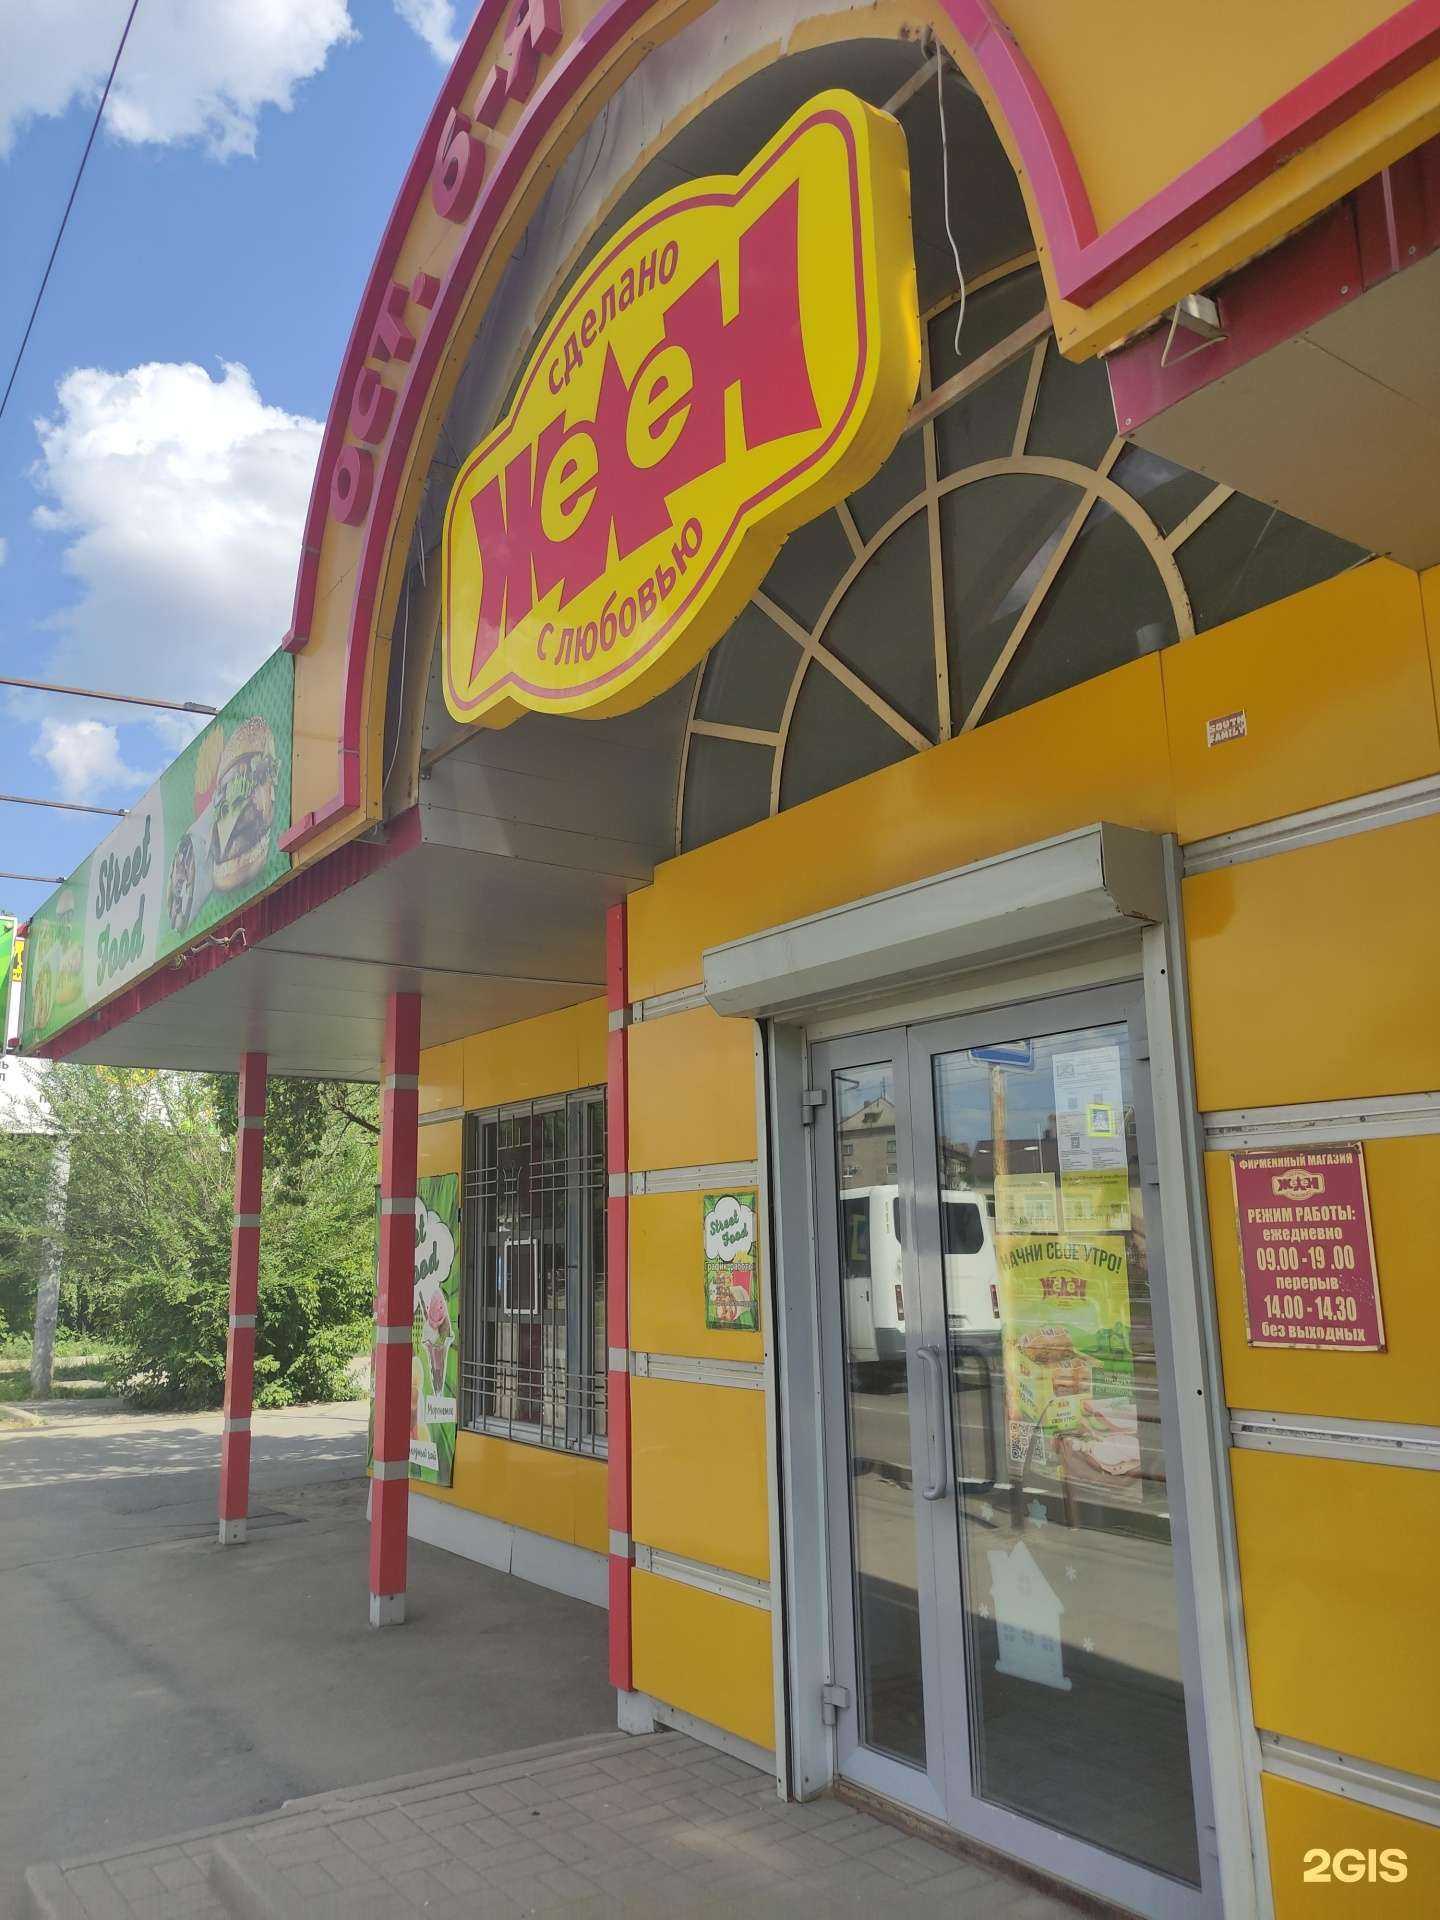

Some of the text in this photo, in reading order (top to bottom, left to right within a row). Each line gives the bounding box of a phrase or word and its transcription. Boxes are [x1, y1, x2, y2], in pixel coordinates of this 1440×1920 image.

[548, 240, 679, 395] сделано
[555, 517, 703, 666] любовью
[96, 814, 151, 919] Street
[97, 893, 145, 986] Food
[1239, 1152, 1353, 1169] ФИРМЕННЫЙ МАГАЗИН
[1248, 1205, 1356, 1223] РЕЖИМ РАБОТЫ:
[721, 1222, 748, 1247] Food
[1263, 1227, 1343, 1243] ежедневно
[413, 1241, 440, 1286] ood
[1083, 1243, 1123, 1275] УТРО!
[1256, 1246, 1299, 1271] 09.00
[1276, 1276, 1340, 1291] перерыв
[1264, 1295, 1304, 1320] 14.00
[1315, 1296, 1357, 1321] 14.30
[1262, 1321, 1365, 1342] без выходных
